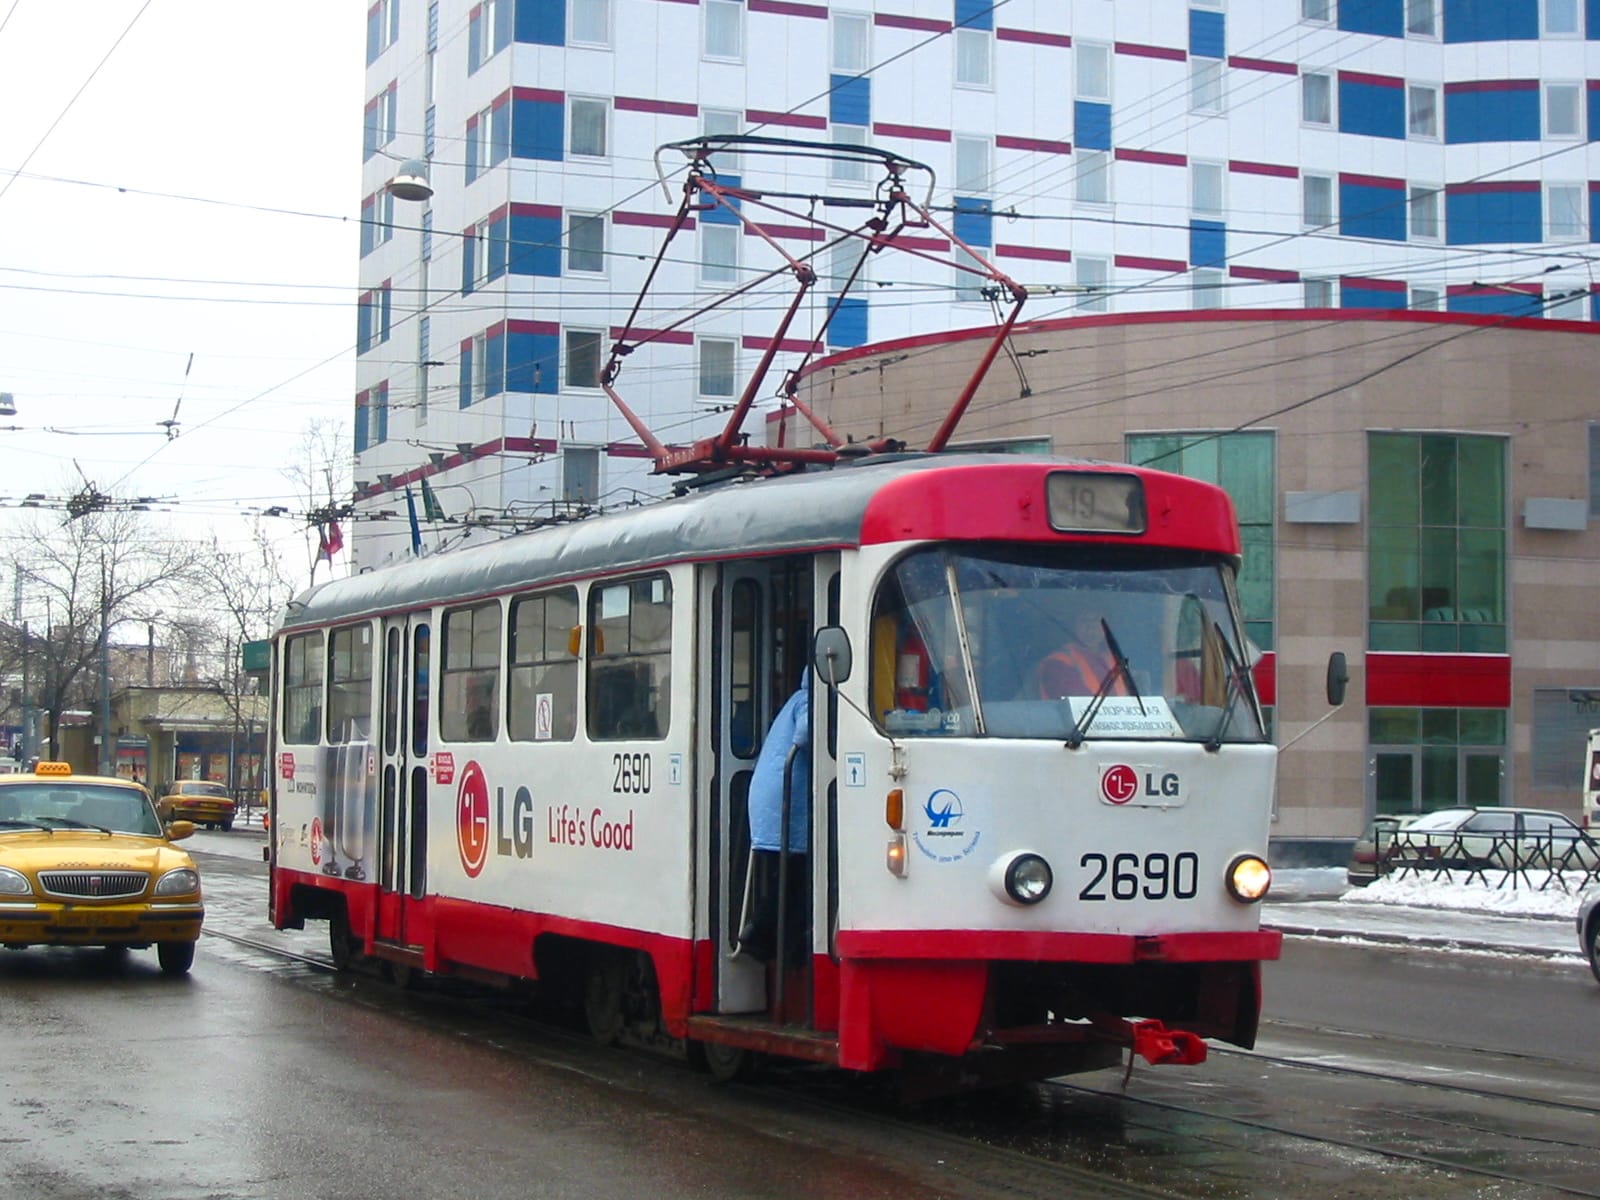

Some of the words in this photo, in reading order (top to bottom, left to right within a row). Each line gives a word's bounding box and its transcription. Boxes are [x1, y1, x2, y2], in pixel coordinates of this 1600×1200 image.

[1070, 485, 1095, 518] 19
[613, 753, 651, 794] 2690
[1145, 773, 1180, 797] LG
[497, 786, 533, 859] LG
[549, 804, 586, 846] Life's
[590, 808, 633, 851] Good
[1079, 852, 1198, 900] 2690
